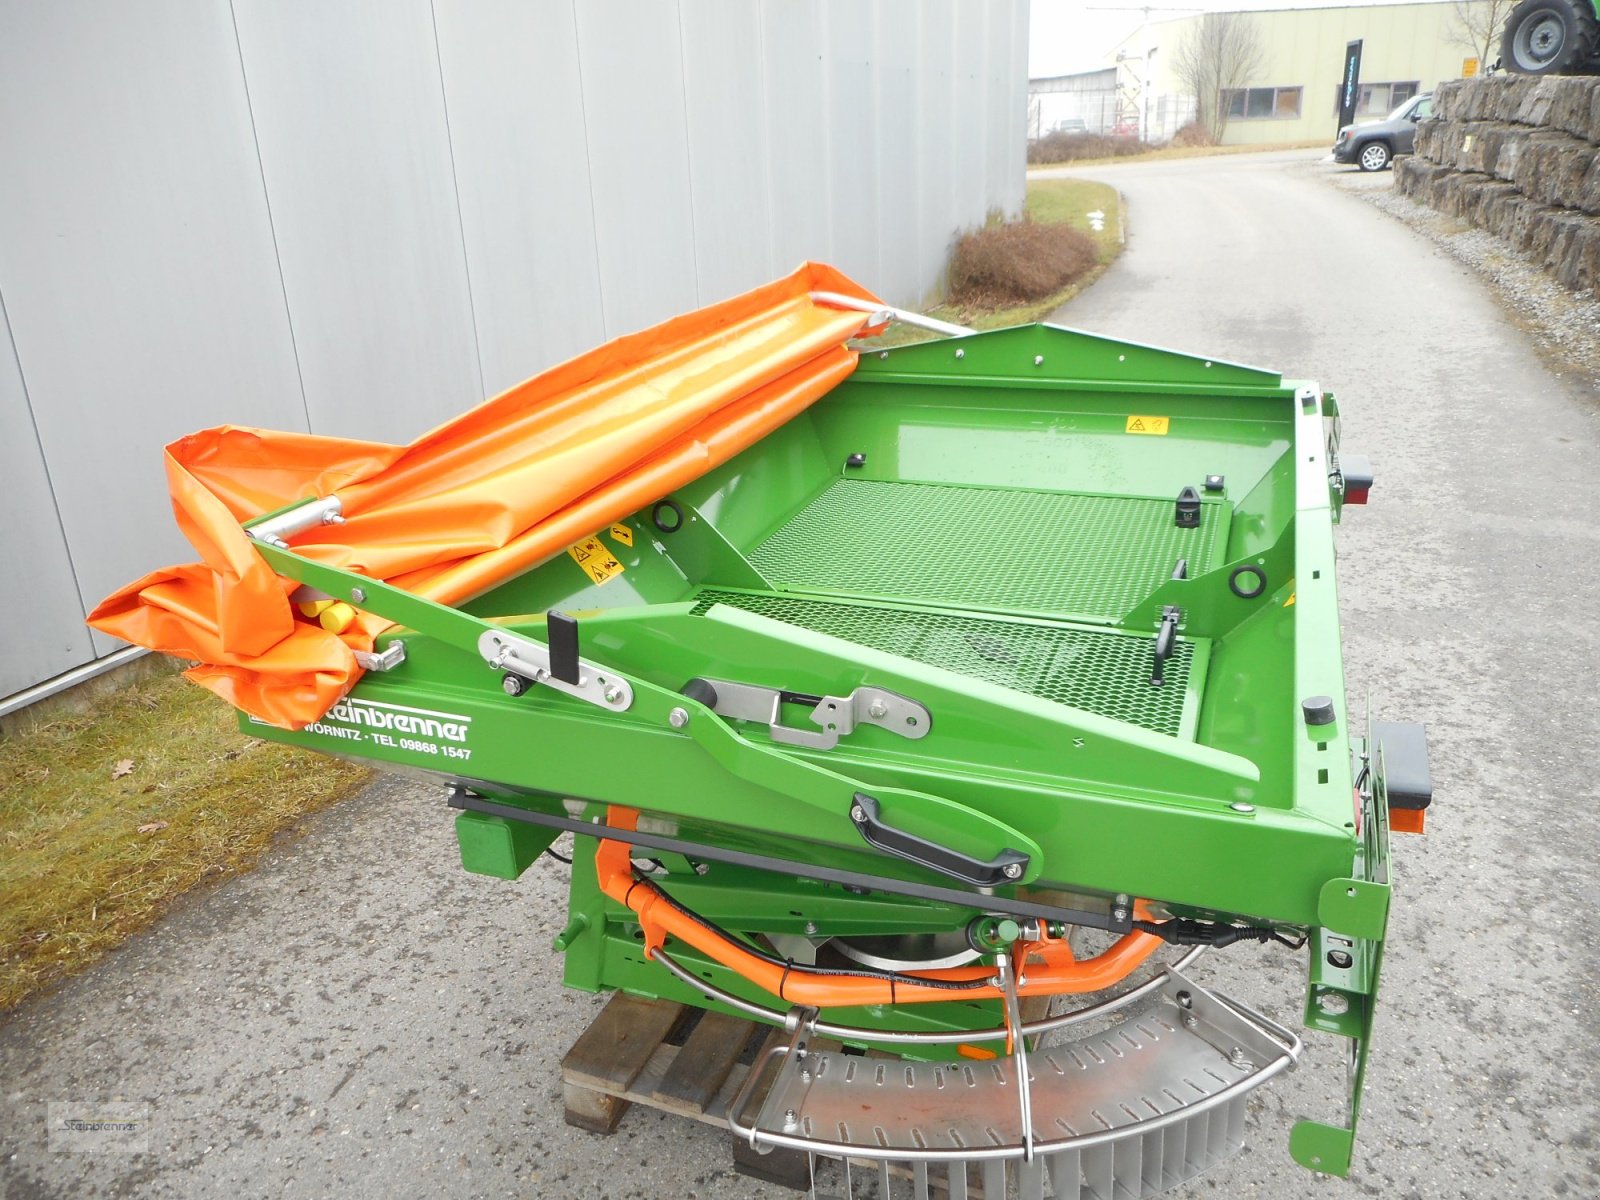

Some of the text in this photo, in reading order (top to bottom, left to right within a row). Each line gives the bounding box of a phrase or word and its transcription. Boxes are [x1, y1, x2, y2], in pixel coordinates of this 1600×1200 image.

[304, 722, 472, 760] WÖRNITZ TEL 09868 1547
